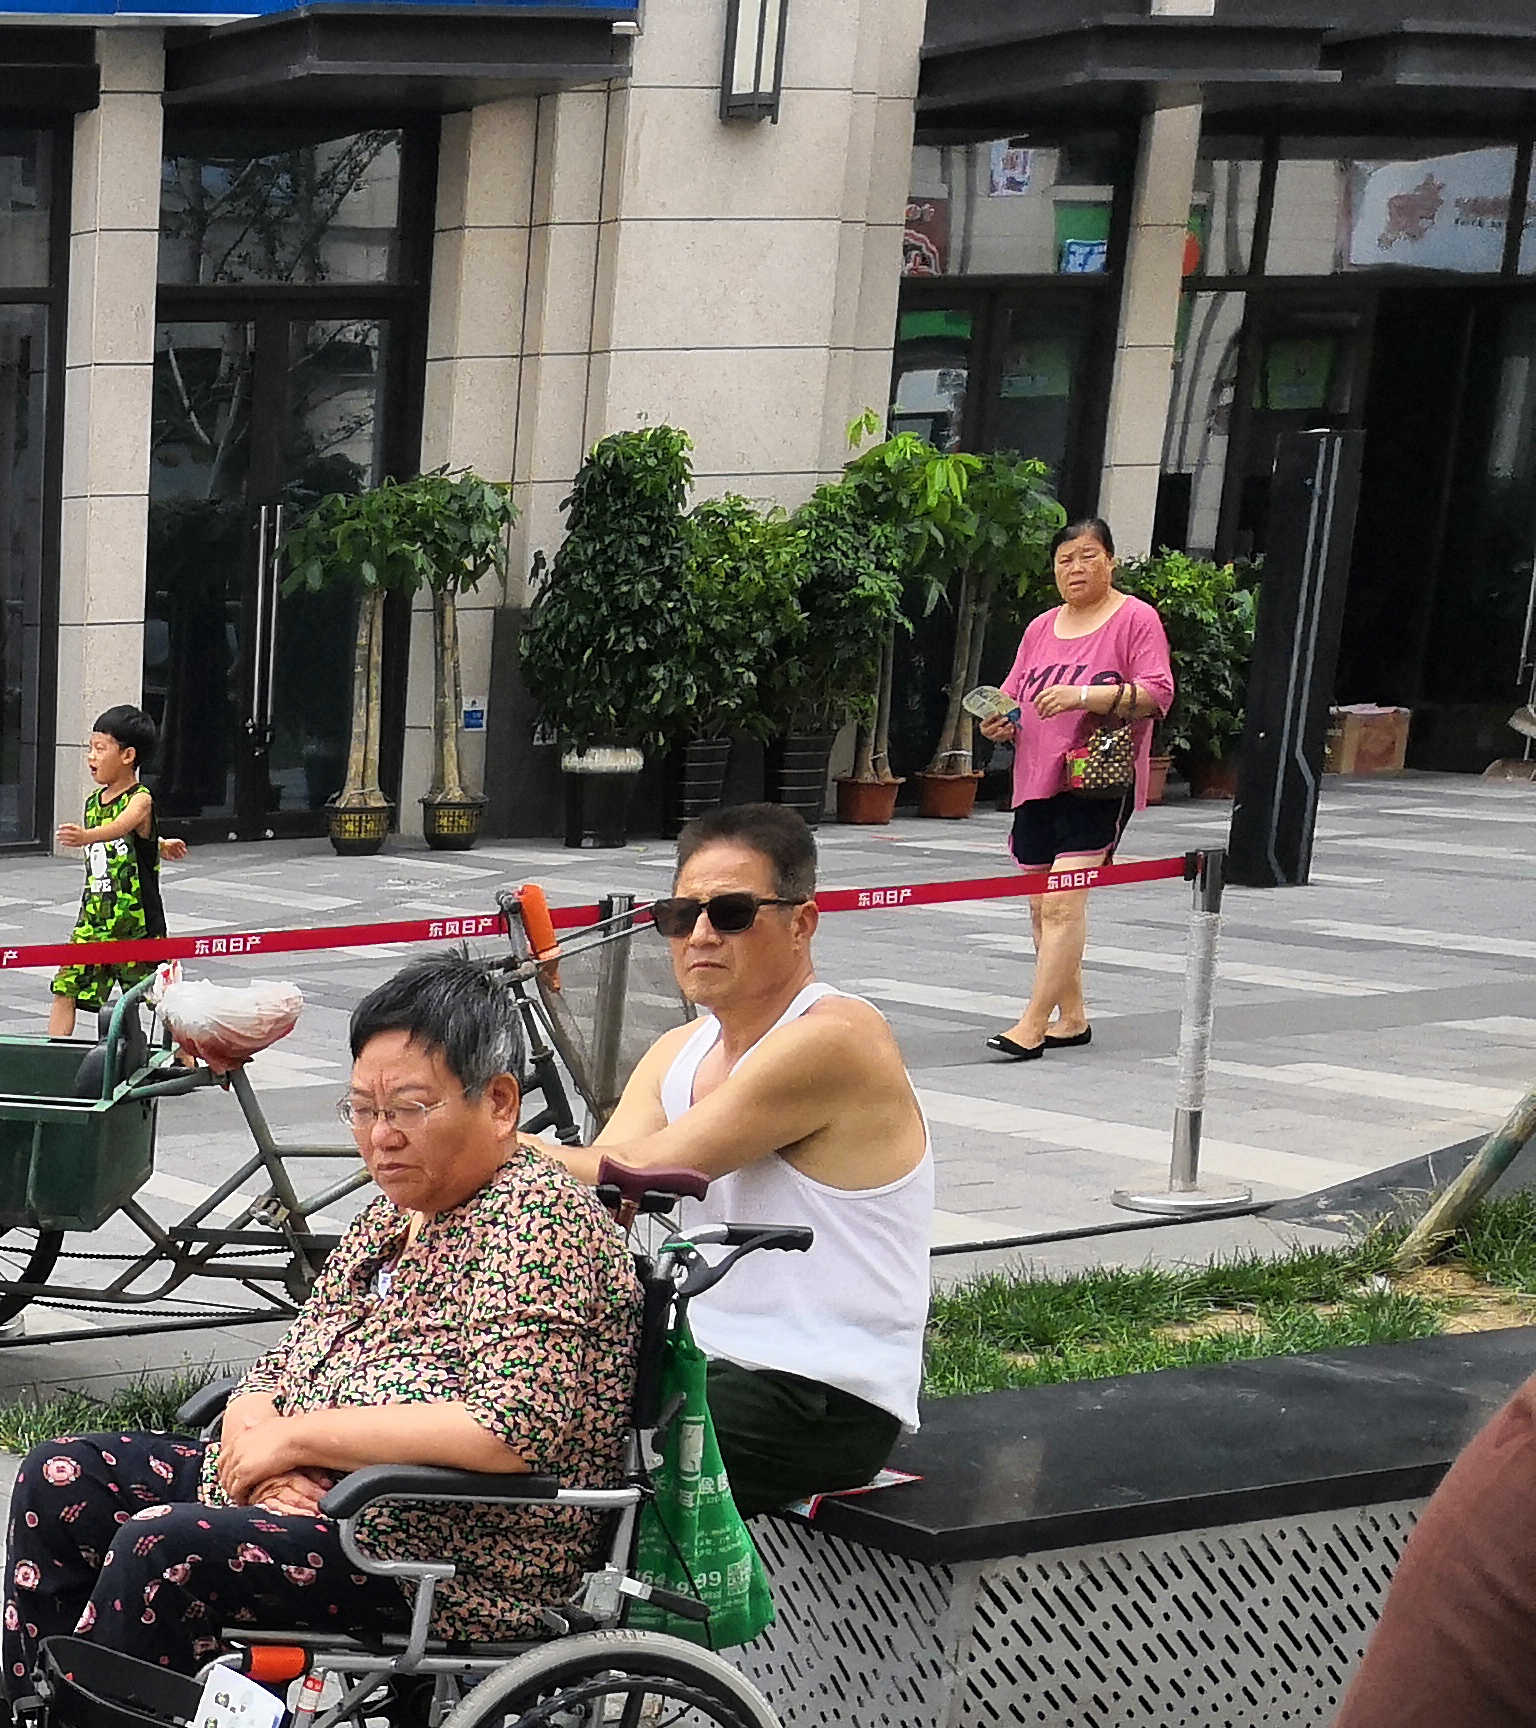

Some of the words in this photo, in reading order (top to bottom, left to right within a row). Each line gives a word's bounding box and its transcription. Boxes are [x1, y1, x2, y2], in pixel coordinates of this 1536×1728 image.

[1047, 870, 1099, 890] 东风日产
[857, 888, 912, 907] 东风日产
[428, 917, 493, 937] 东风日产
[194, 935, 261, 955] 东风日产
